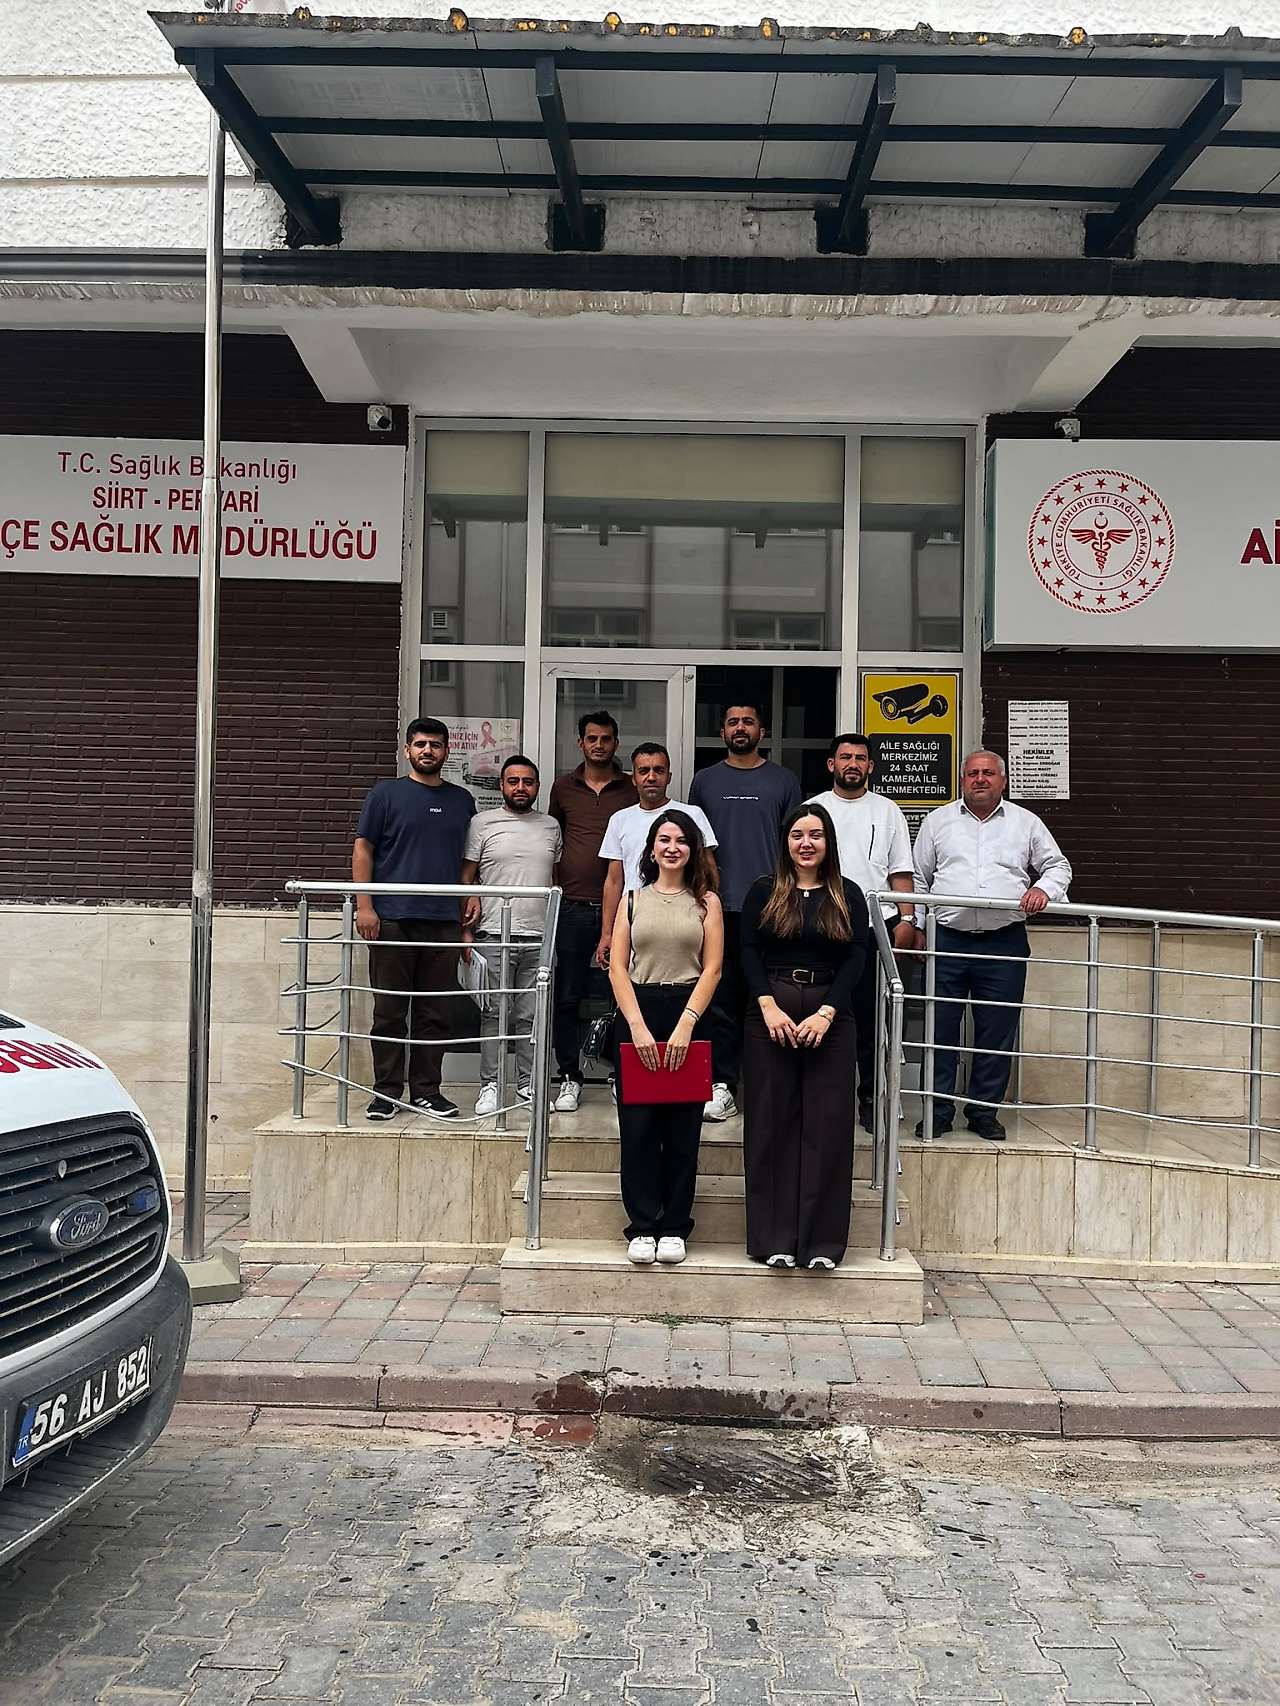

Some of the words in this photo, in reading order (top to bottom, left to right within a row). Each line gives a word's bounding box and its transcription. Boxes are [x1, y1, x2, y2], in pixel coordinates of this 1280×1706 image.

[58, 452, 101, 474] T.C.
[109, 453, 181, 481] Sağlık
[191, 456, 297, 484] Bkanlığı
[92, 482, 148, 510] SİİRT
[168, 486, 259, 513] PEARİ
[1113, 498, 1143, 526] SAĞLIK
[1056, 496, 1110, 538] CUMHURİYETİ
[50, 513, 163, 555] SAĞLIK
[173, 518, 378, 560] MDÜRLÜĞÜ
[1056, 542, 1081, 580] TÜRKİYE
[1122, 528, 1148, 580] BAKANLIĞI
[880, 740, 900, 750] AİLE
[902, 740, 940, 750] SAĞLIĞI
[881, 752, 938, 761] MERKEZİMİZ
[881, 775, 921, 783] KAMERA
[923, 773, 938, 783] İLE
[890, 763, 900, 772] 24
[905, 764, 929, 772] SAAT
[872, 784, 946, 794] İZLENMEKTEDİR
[71, 1211, 101, 1240] Ford
[30, 1394, 68, 1445] 56
[77, 1370, 107, 1423] AJ
[117, 1345, 147, 1399] 852
[18, 1435, 29, 1450] TR
